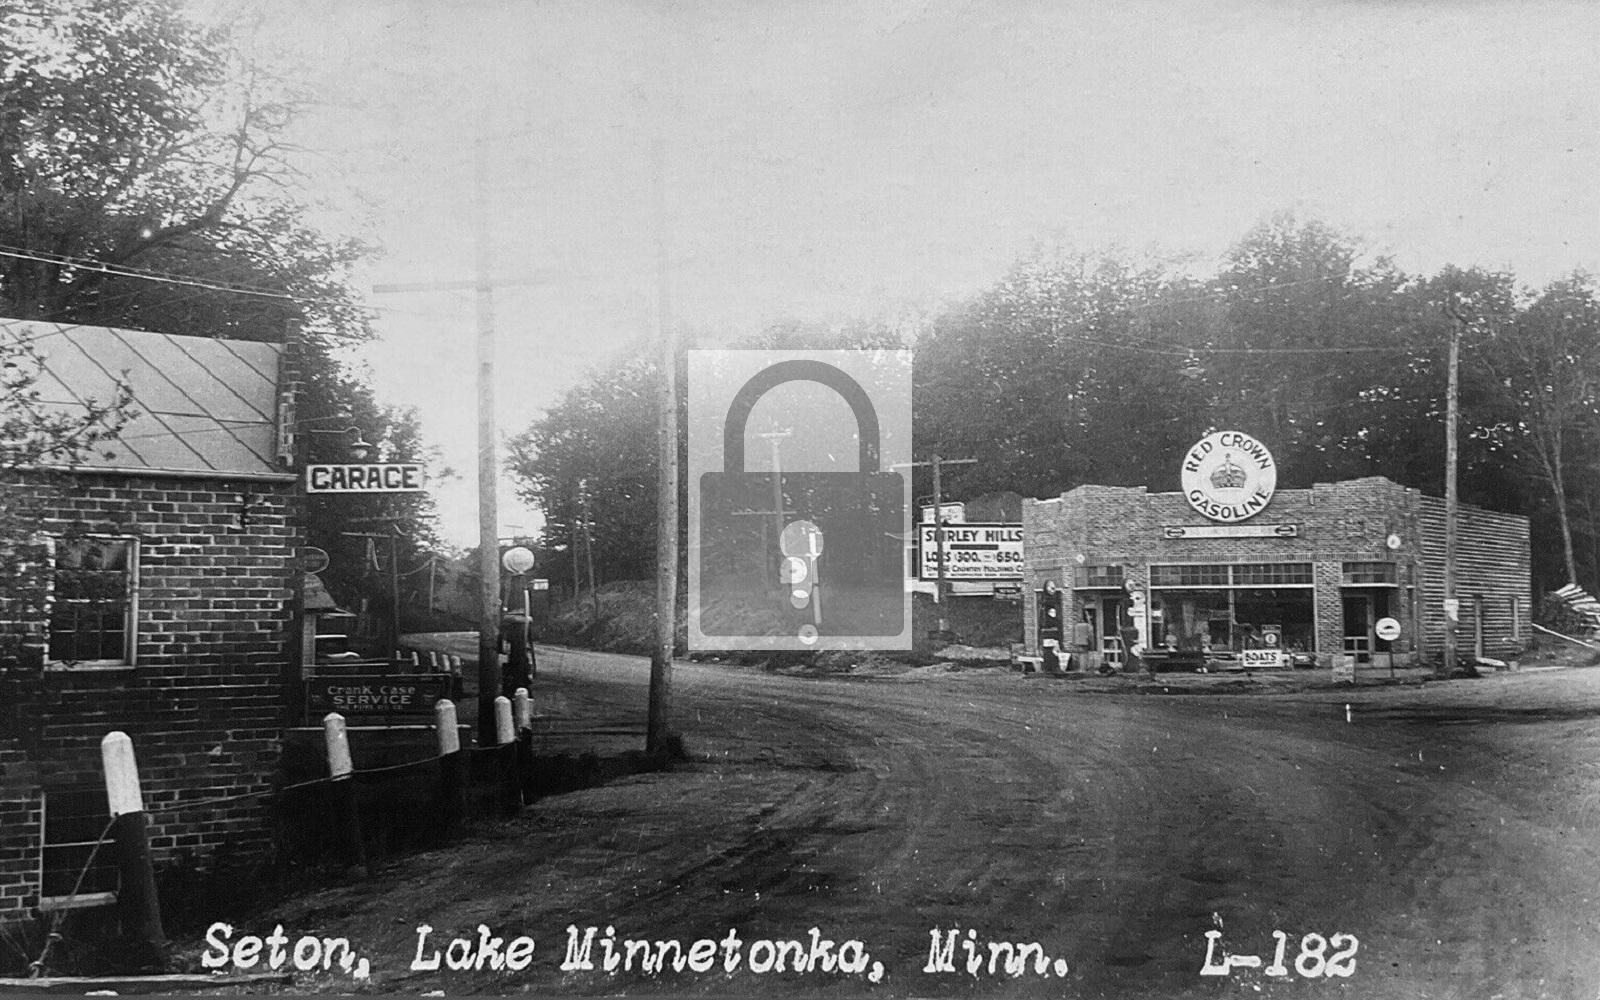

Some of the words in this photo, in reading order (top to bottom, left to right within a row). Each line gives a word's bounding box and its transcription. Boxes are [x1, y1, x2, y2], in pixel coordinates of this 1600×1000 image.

[1185, 441, 1213, 472] RED
[1220, 433, 1271, 470] CROWN
[311, 466, 418, 490] GARAGE
[1189, 487, 1270, 519] GASOLINE
[925, 530, 978, 542] SRLEY
[985, 530, 1023, 541] HILLS
[925, 551, 951, 563] LOS
[1245, 652, 1277, 662] BOATS
[333, 695, 412, 705] SERVICE
